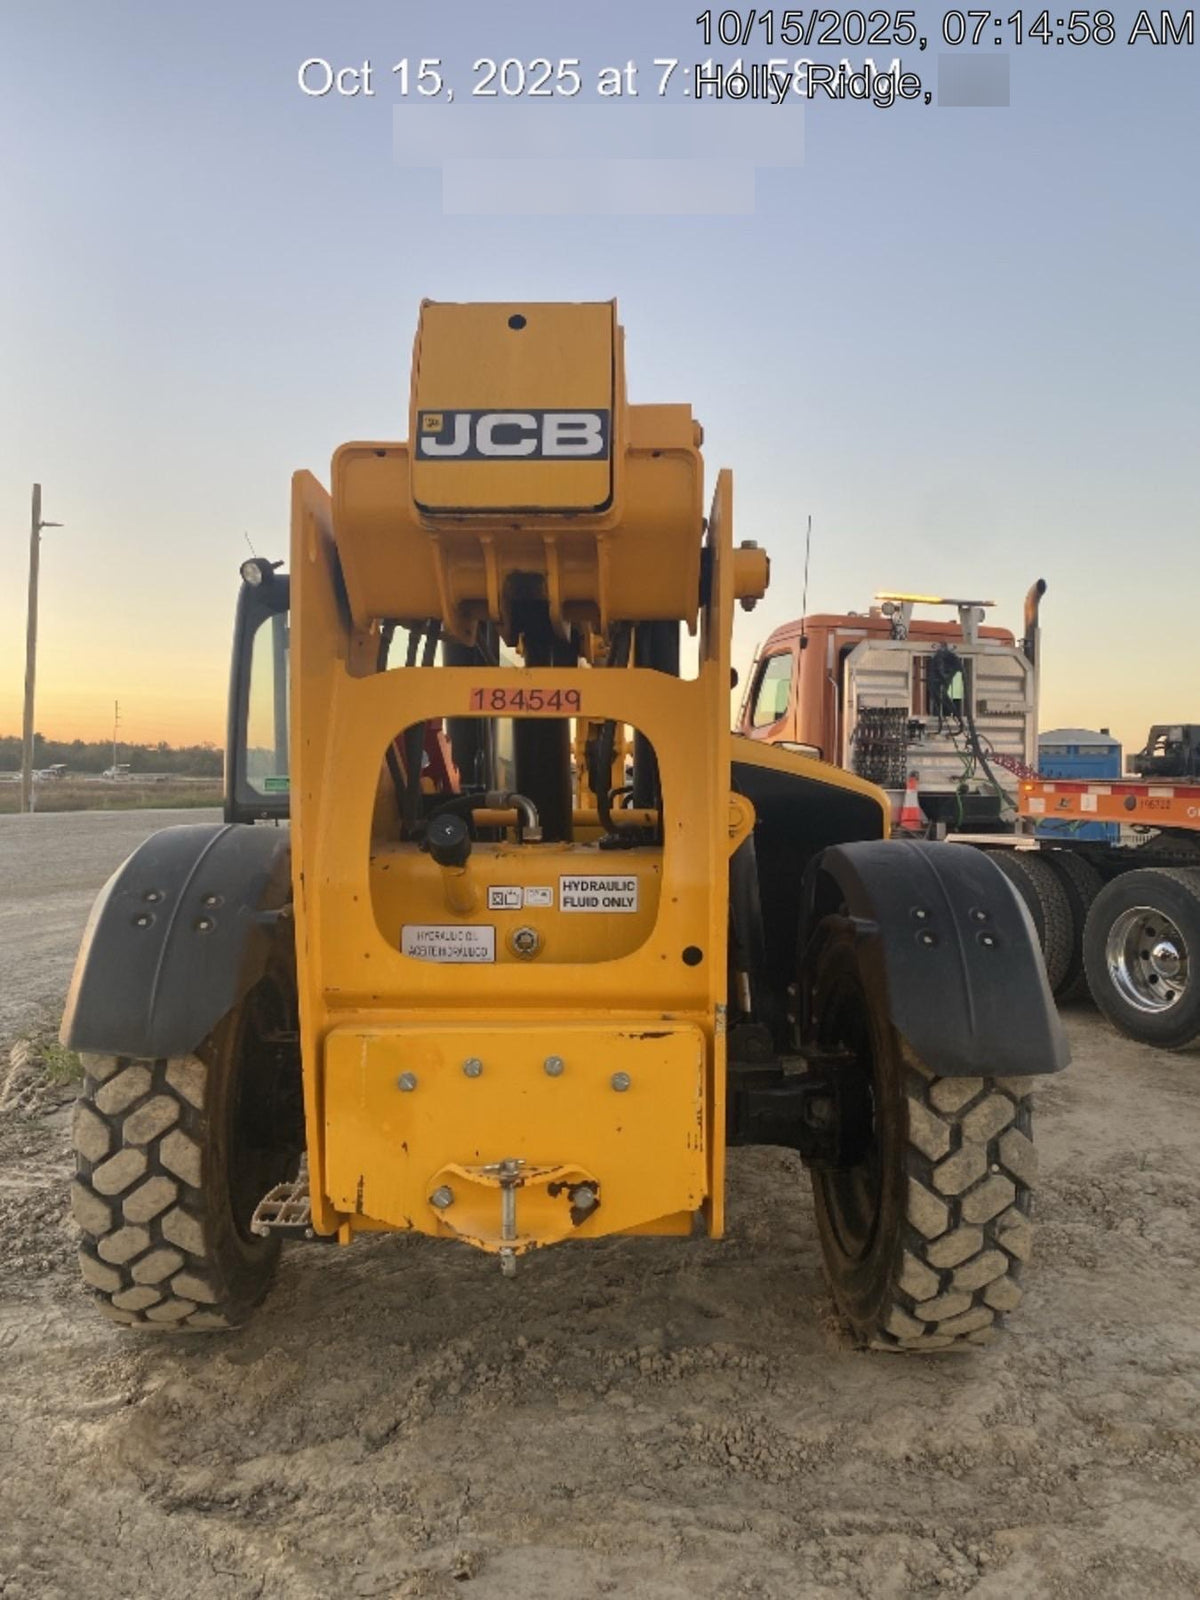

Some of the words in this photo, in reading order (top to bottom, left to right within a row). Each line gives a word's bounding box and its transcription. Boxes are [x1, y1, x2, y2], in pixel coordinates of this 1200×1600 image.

[421, 413, 603, 456] JCB
[474, 688, 581, 711] 184549
[563, 881, 635, 892] HYDRAULIC
[563, 897, 599, 908] FLUID
[602, 897, 634, 908] ONLY
